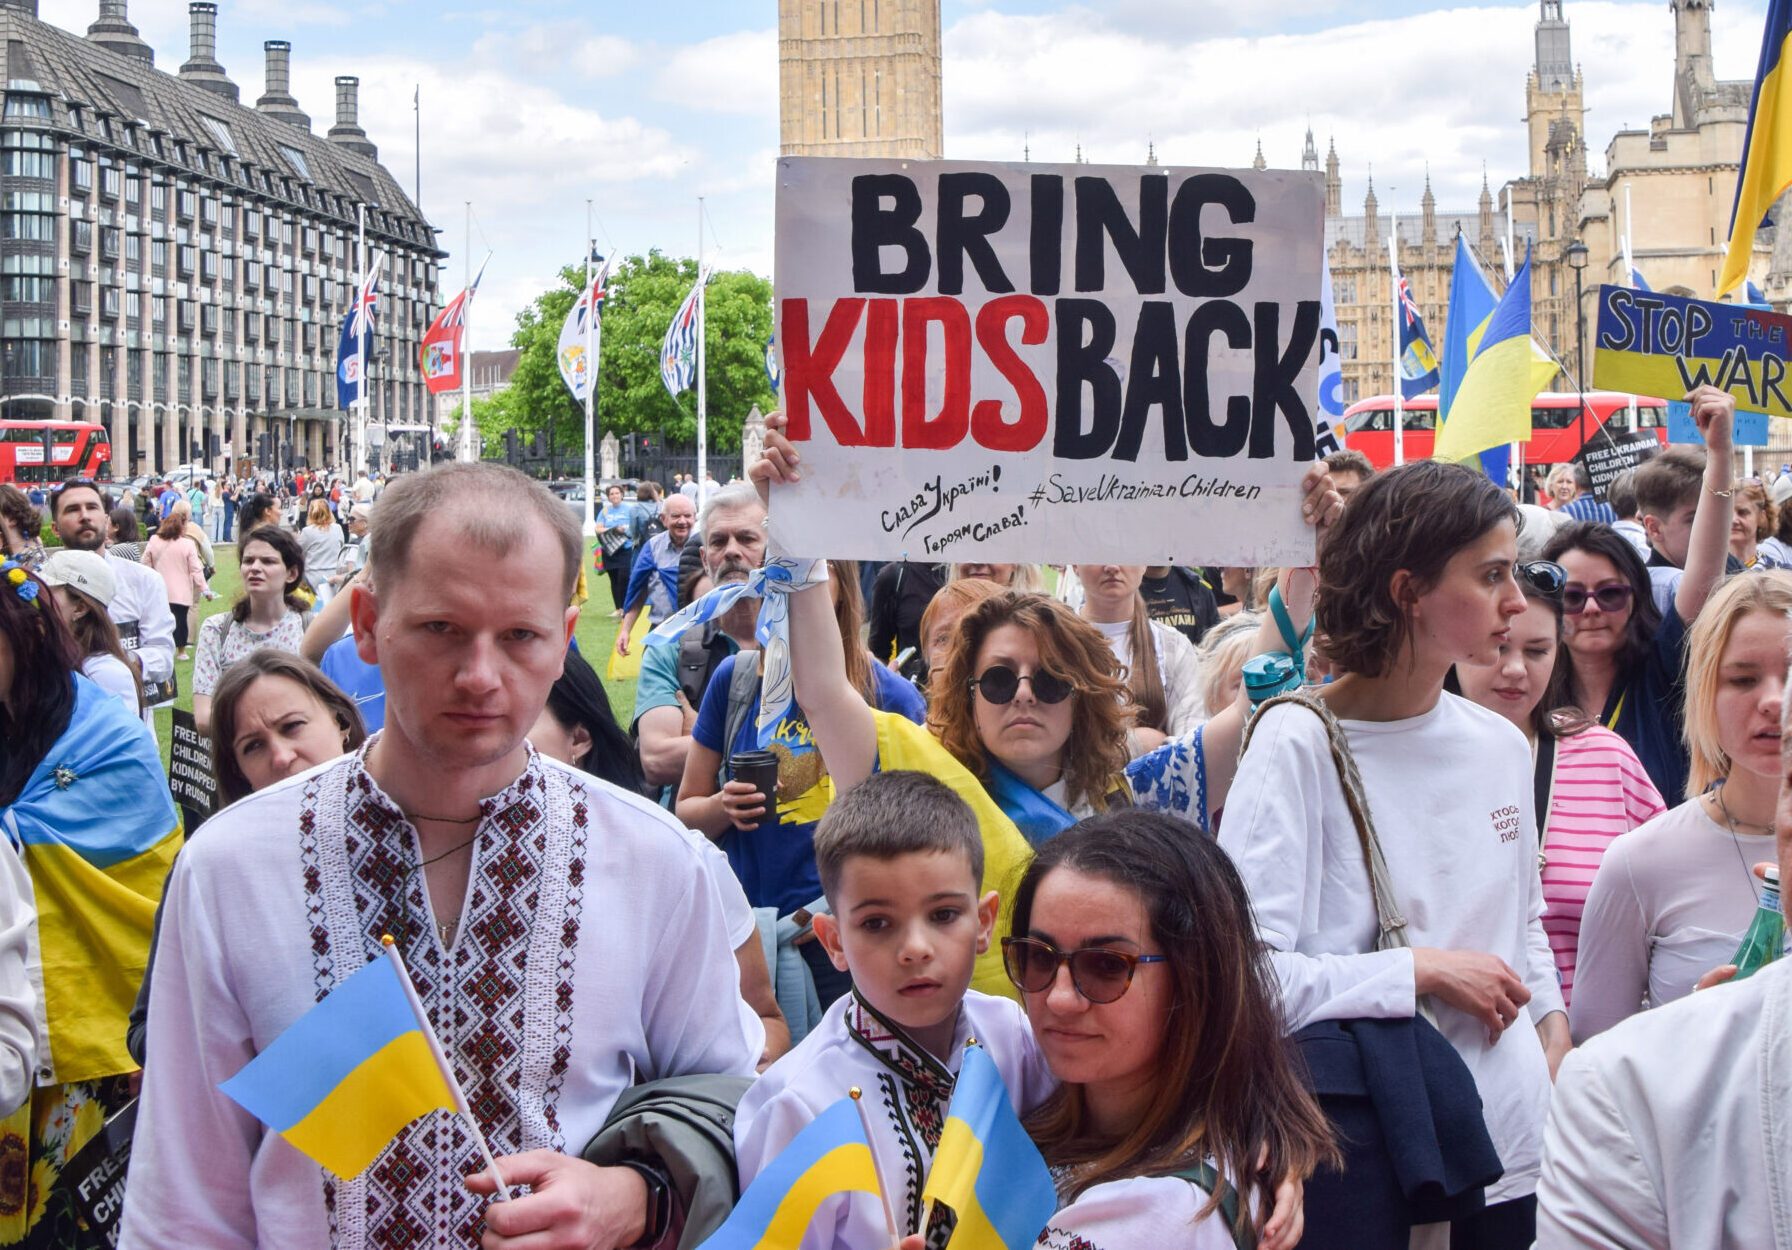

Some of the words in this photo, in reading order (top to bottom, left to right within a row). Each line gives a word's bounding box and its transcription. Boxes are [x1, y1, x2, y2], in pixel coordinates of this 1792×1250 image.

[852, 172, 1256, 297] BRING
[1602, 290, 1712, 358] STOP
[1731, 318, 1784, 343] THE
[782, 295, 1049, 451] KIDS
[1053, 300, 1322, 462] BACK
[1675, 345, 1792, 413] WAR
[1585, 448, 1611, 462] FREE
[1588, 454, 1635, 473] CHILDREN
[902, 464, 1002, 542] Україні!
[1594, 485, 1606, 495] BY
[881, 494, 928, 533] Слава
[973, 505, 1028, 542] Слава!
[119, 636, 138, 650] REE
[174, 725, 197, 744] FREE
[173, 743, 212, 771] CHILDREN
[172, 761, 217, 791] KIDNAPPED
[171, 778, 184, 793] BY
[185, 783, 210, 808] RUSSIA
[1494, 817, 1519, 831] КОГО
[78, 1138, 131, 1202] FREE
